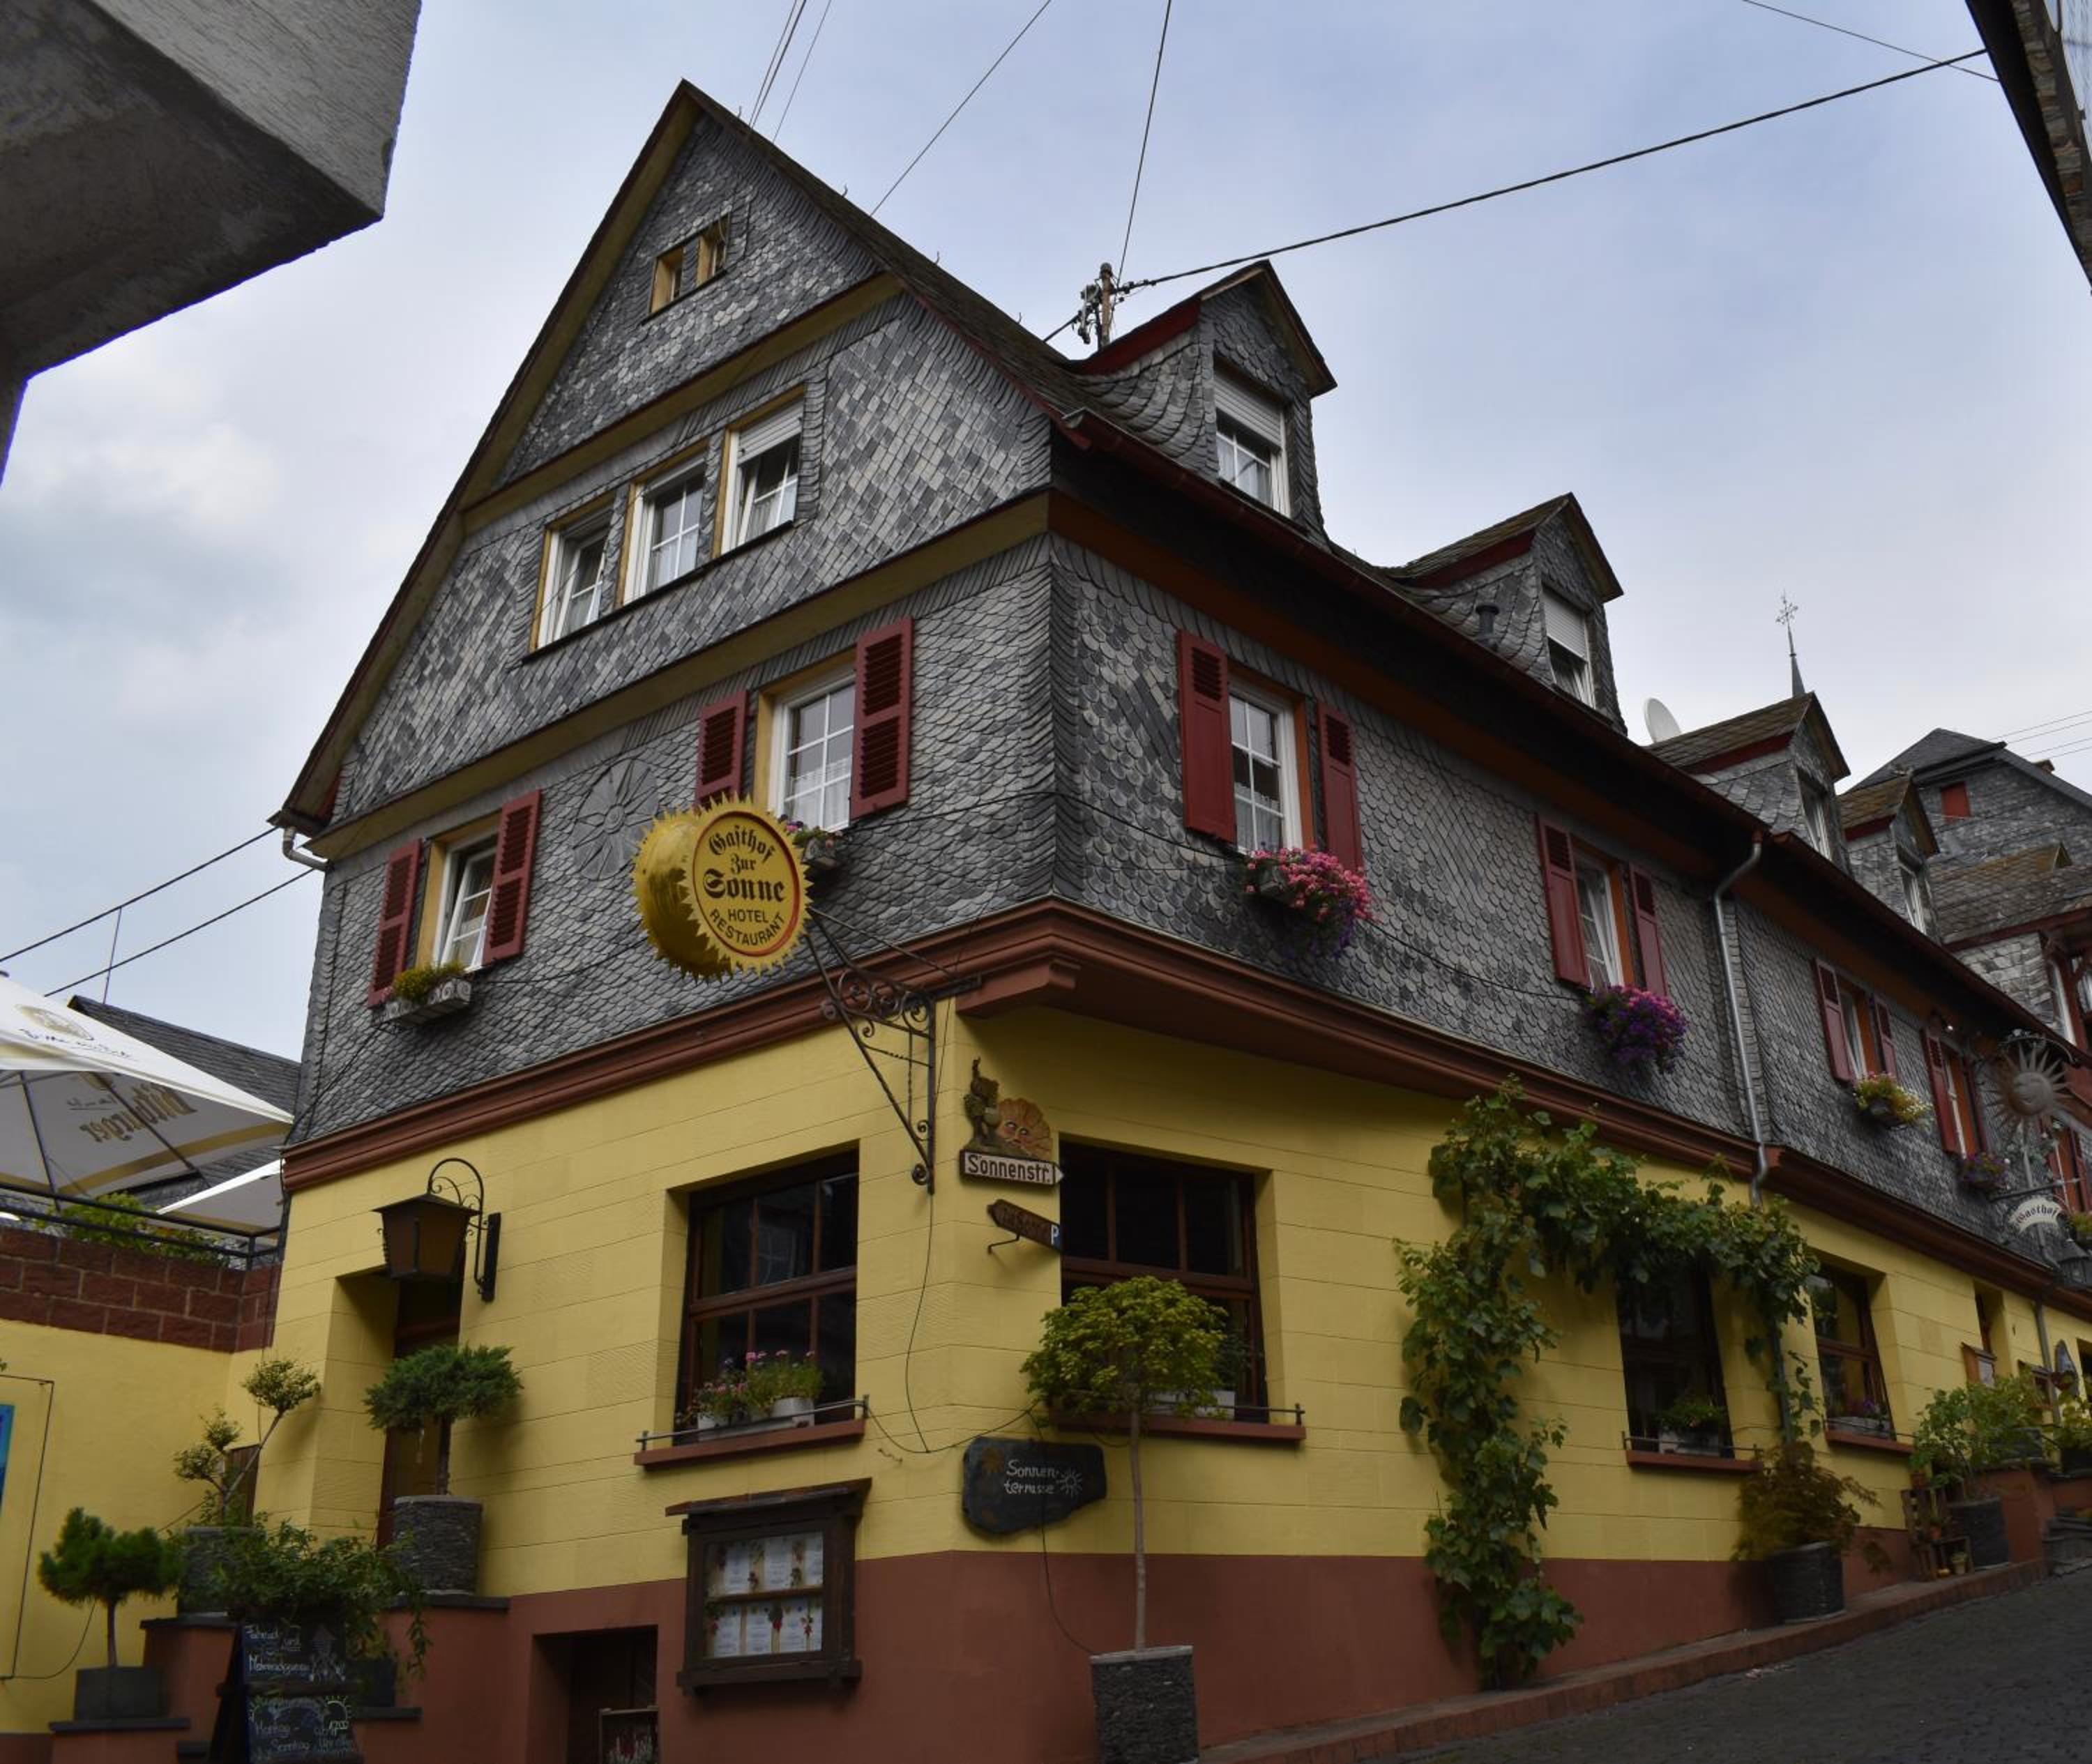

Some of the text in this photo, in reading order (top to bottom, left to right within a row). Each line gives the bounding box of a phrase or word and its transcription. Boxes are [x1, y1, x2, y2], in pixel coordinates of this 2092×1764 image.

[703, 869, 785, 902] Sonne
[709, 908, 785, 946] RESTAURANT
[728, 908, 769, 923] HOTEL
[967, 1154, 1051, 1183] Sonnenstr.
[1051, 1225, 1060, 1247] P
